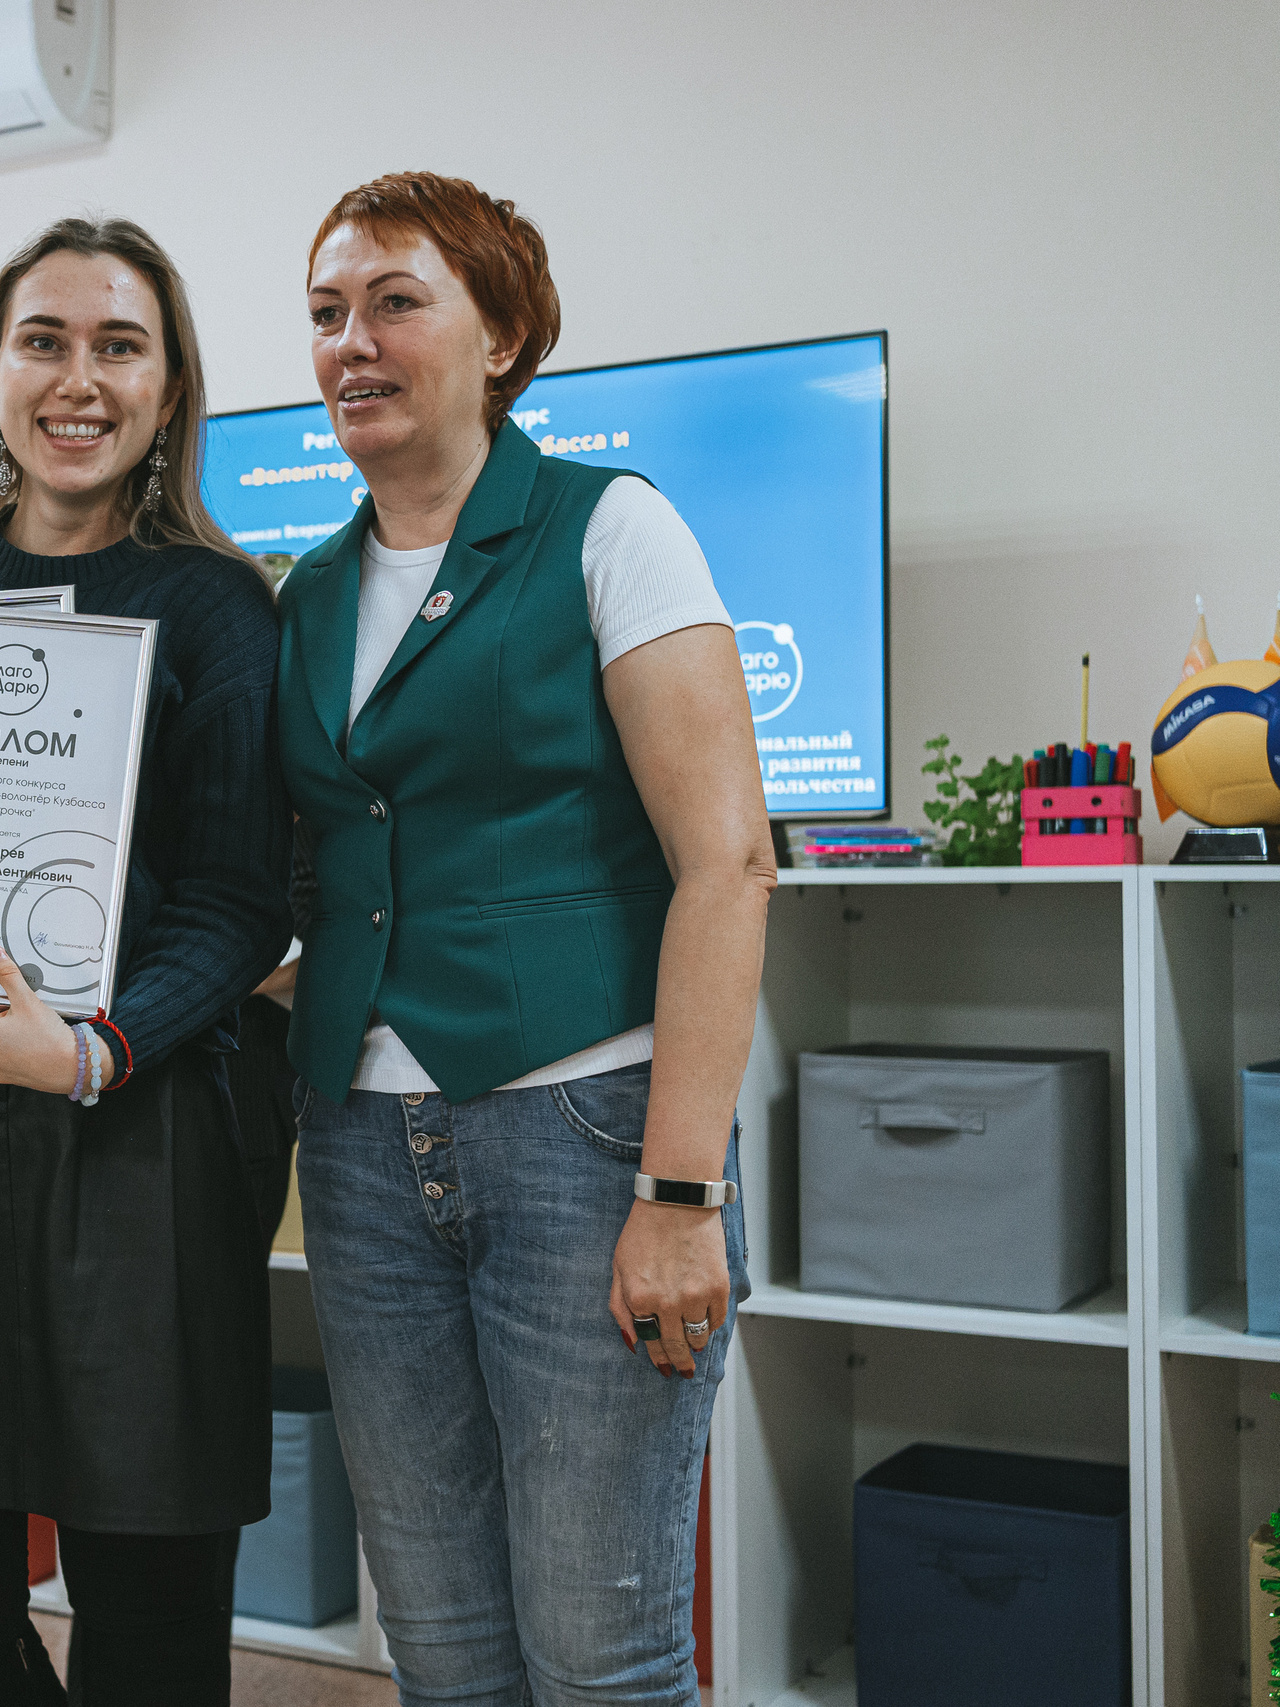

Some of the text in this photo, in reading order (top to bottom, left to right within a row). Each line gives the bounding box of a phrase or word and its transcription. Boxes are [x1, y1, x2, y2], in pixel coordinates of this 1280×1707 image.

[508, 408, 550, 431] урс
[534, 434, 607, 455] басса
[612, 431, 629, 448] и
[740, 651, 779, 670] аго
[745, 671, 791, 695] арю
[1163, 694, 1216, 741] MIKASA
[15, 779, 66, 791] конкурса
[764, 777, 876, 795] вольчества
[53, 795, 106, 810] Кузбасса
